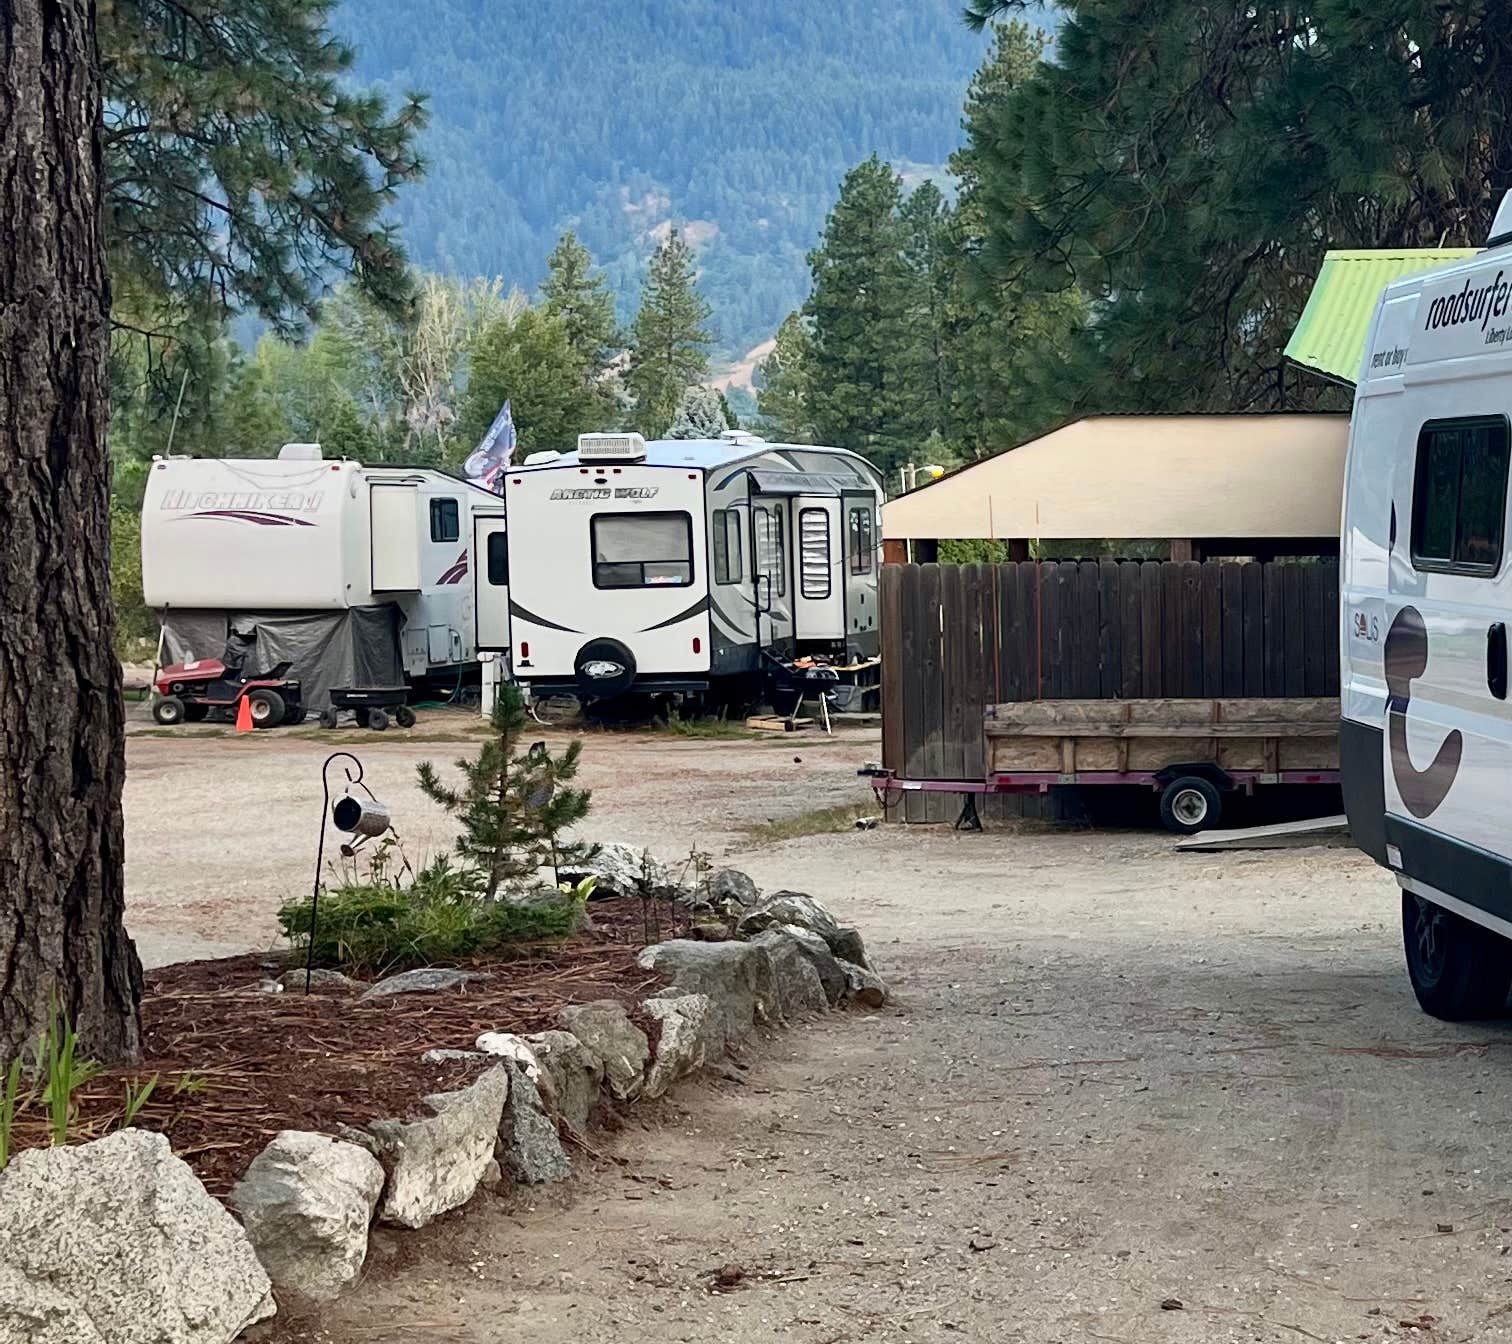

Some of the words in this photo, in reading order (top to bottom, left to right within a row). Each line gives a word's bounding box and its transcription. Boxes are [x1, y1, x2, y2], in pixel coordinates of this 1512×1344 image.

[1485, 327, 1505, 346] Liberty
[550, 488, 611, 500] ARCTIC
[614, 487, 659, 499] WOLF
